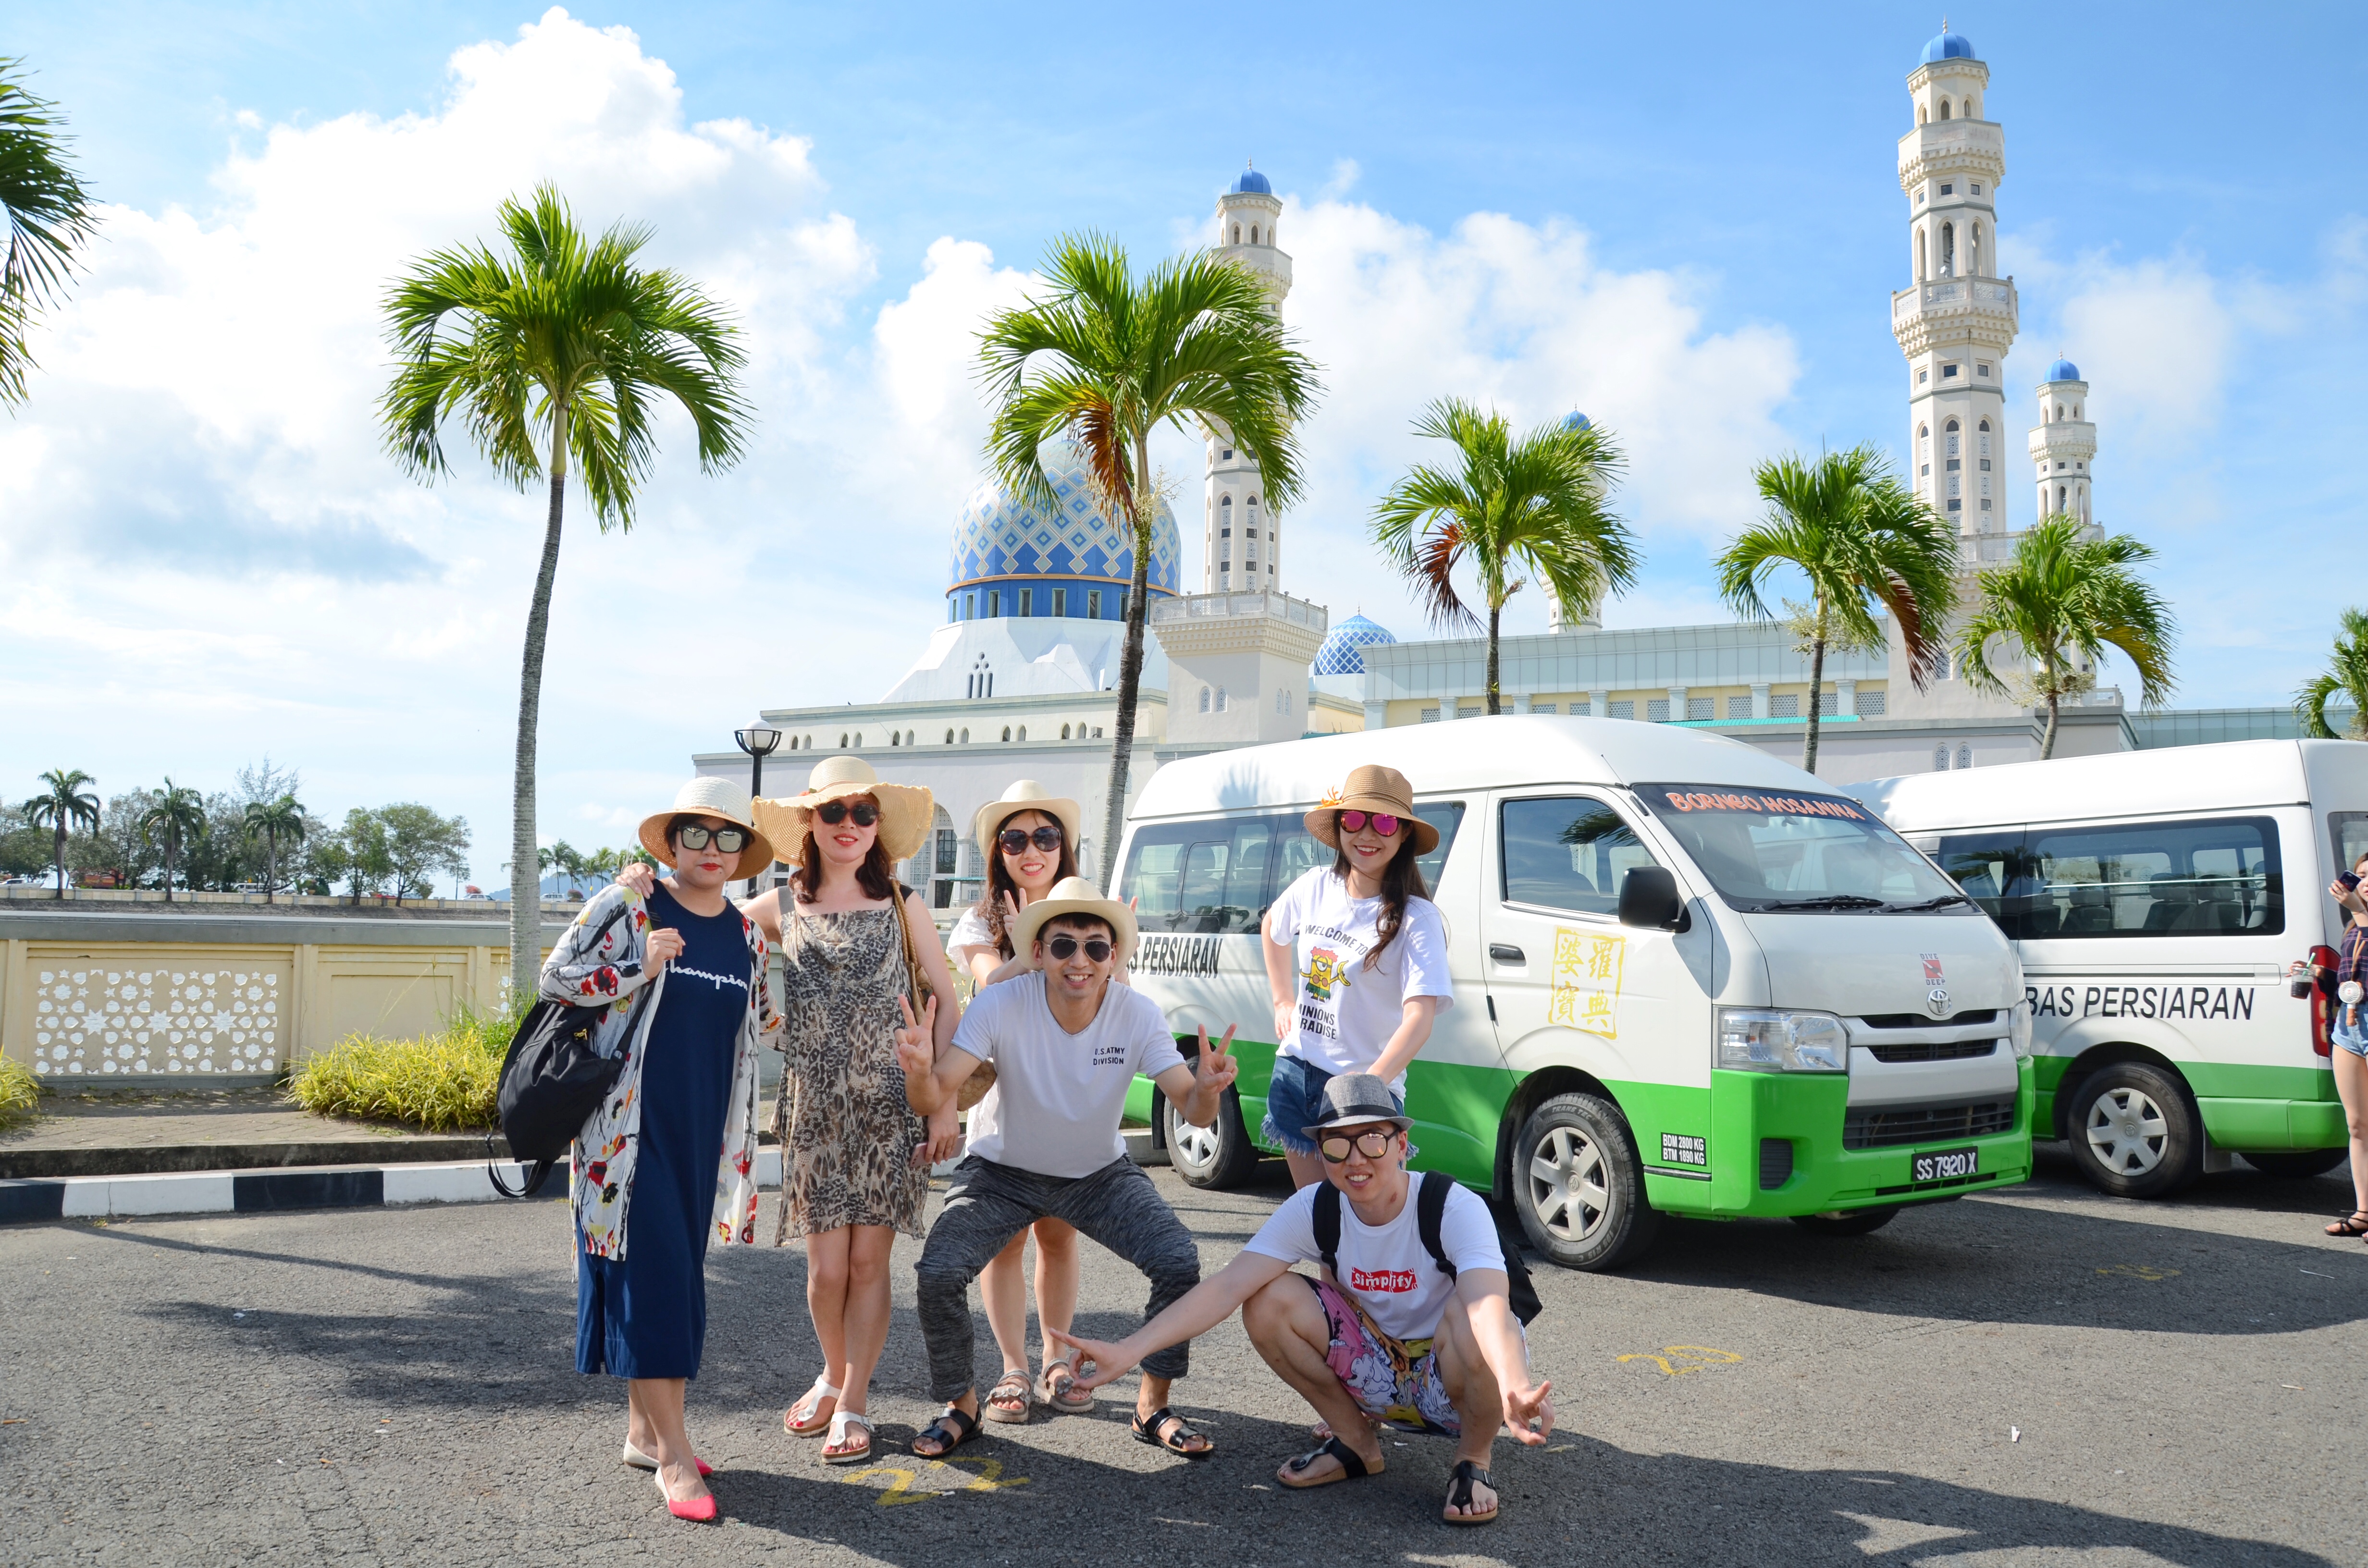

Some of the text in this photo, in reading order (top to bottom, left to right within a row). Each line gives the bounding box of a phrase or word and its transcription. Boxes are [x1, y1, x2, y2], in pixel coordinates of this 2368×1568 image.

[1666, 792, 1865, 821] BORNEO HOSANNA
[1305, 925, 1369, 956] WELCOME TO
[1141, 936, 1223, 979] PERSIARAN
[666, 959, 748, 991] hampion
[2025, 986, 2255, 1020] BAS PERSIARAN
[1299, 1016, 1336, 1040] RADISE
[1093, 1057, 1124, 1065] DIVISION
[1663, 1134, 1704, 1151] BDM 2800 KG
[1663, 1147, 1705, 1165] BTM 1890 KG
[1917, 1152, 1976, 1180] SS 7920 X
[1355, 1273, 1413, 1289] Simplify
